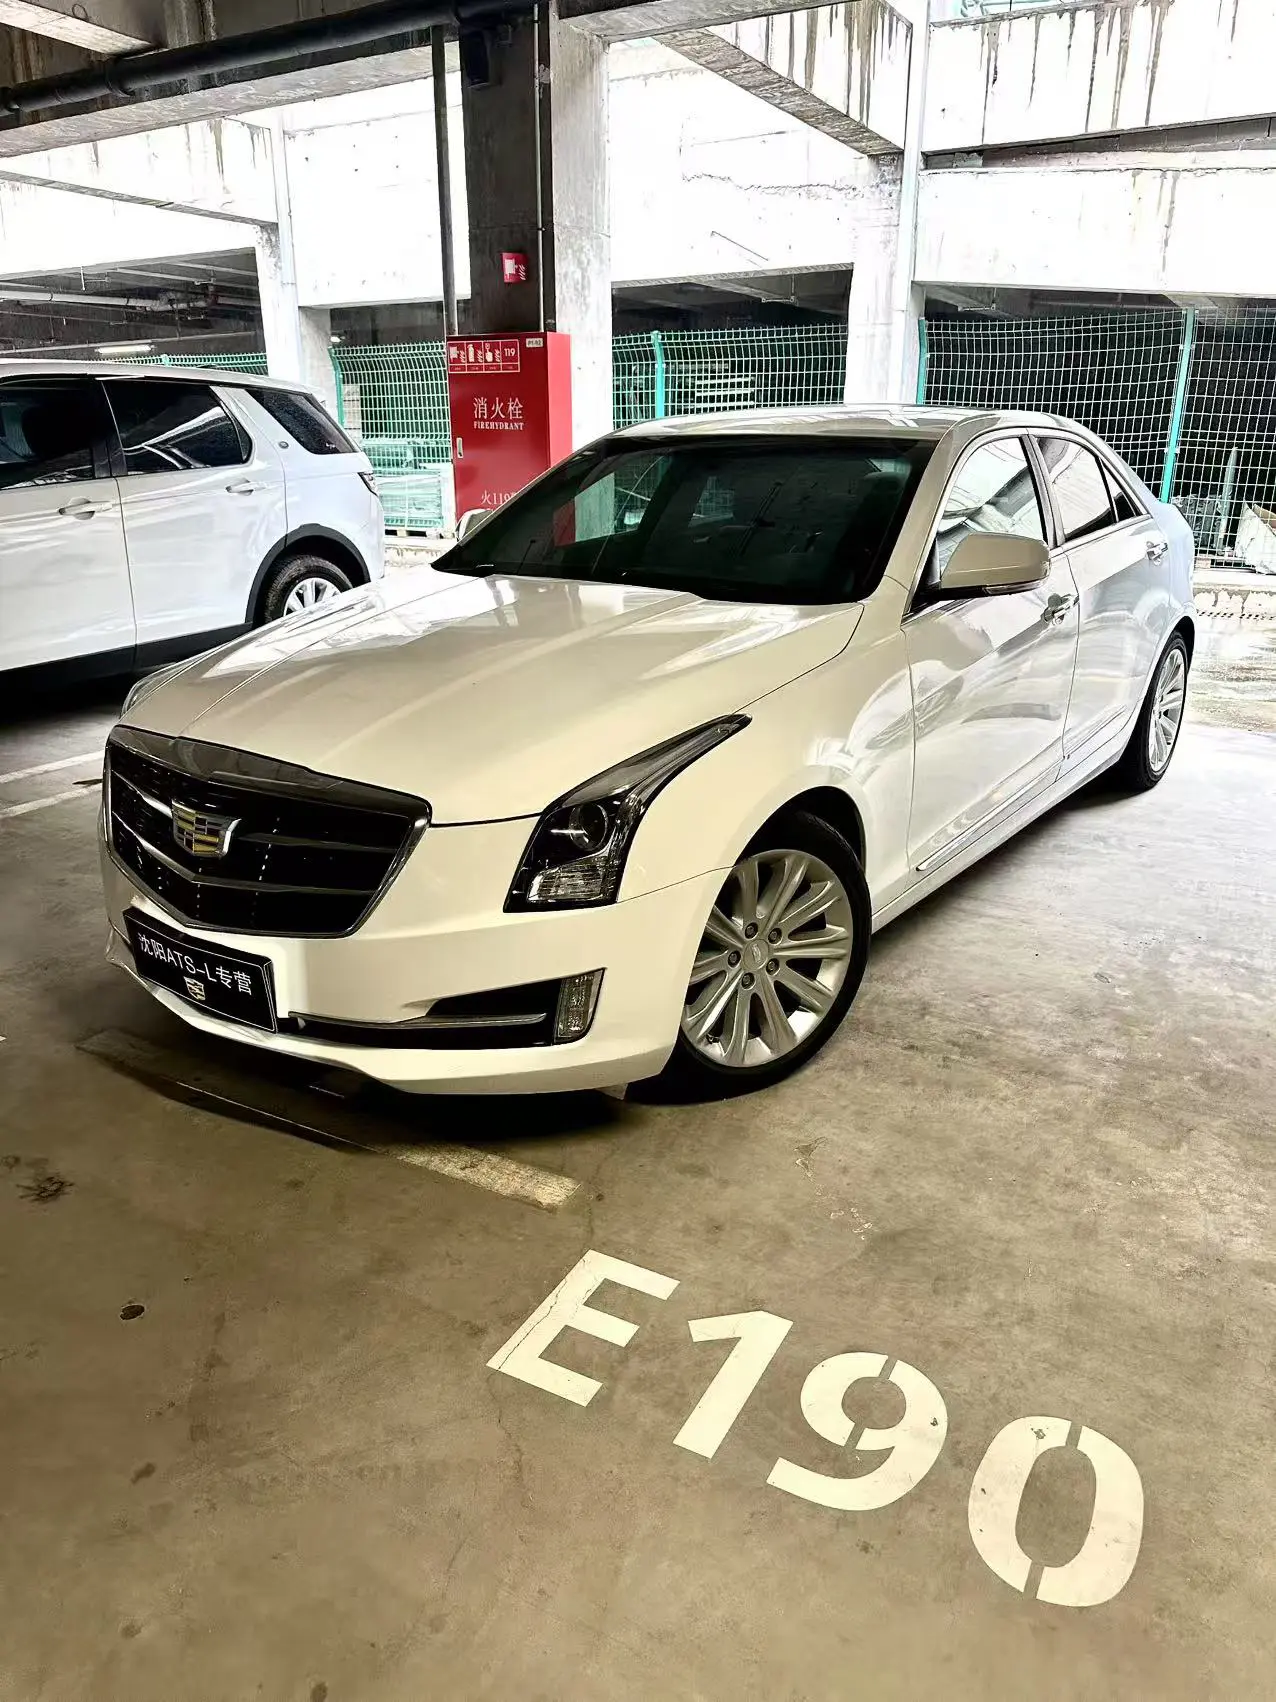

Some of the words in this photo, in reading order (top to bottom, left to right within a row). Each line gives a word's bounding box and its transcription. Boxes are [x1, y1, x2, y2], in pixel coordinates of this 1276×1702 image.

[504, 347, 516, 357] 119
[473, 397, 523, 420] 消火栓
[473, 421, 524, 430] FIREHYDRANT
[486, 1249, 1145, 1608] E190
